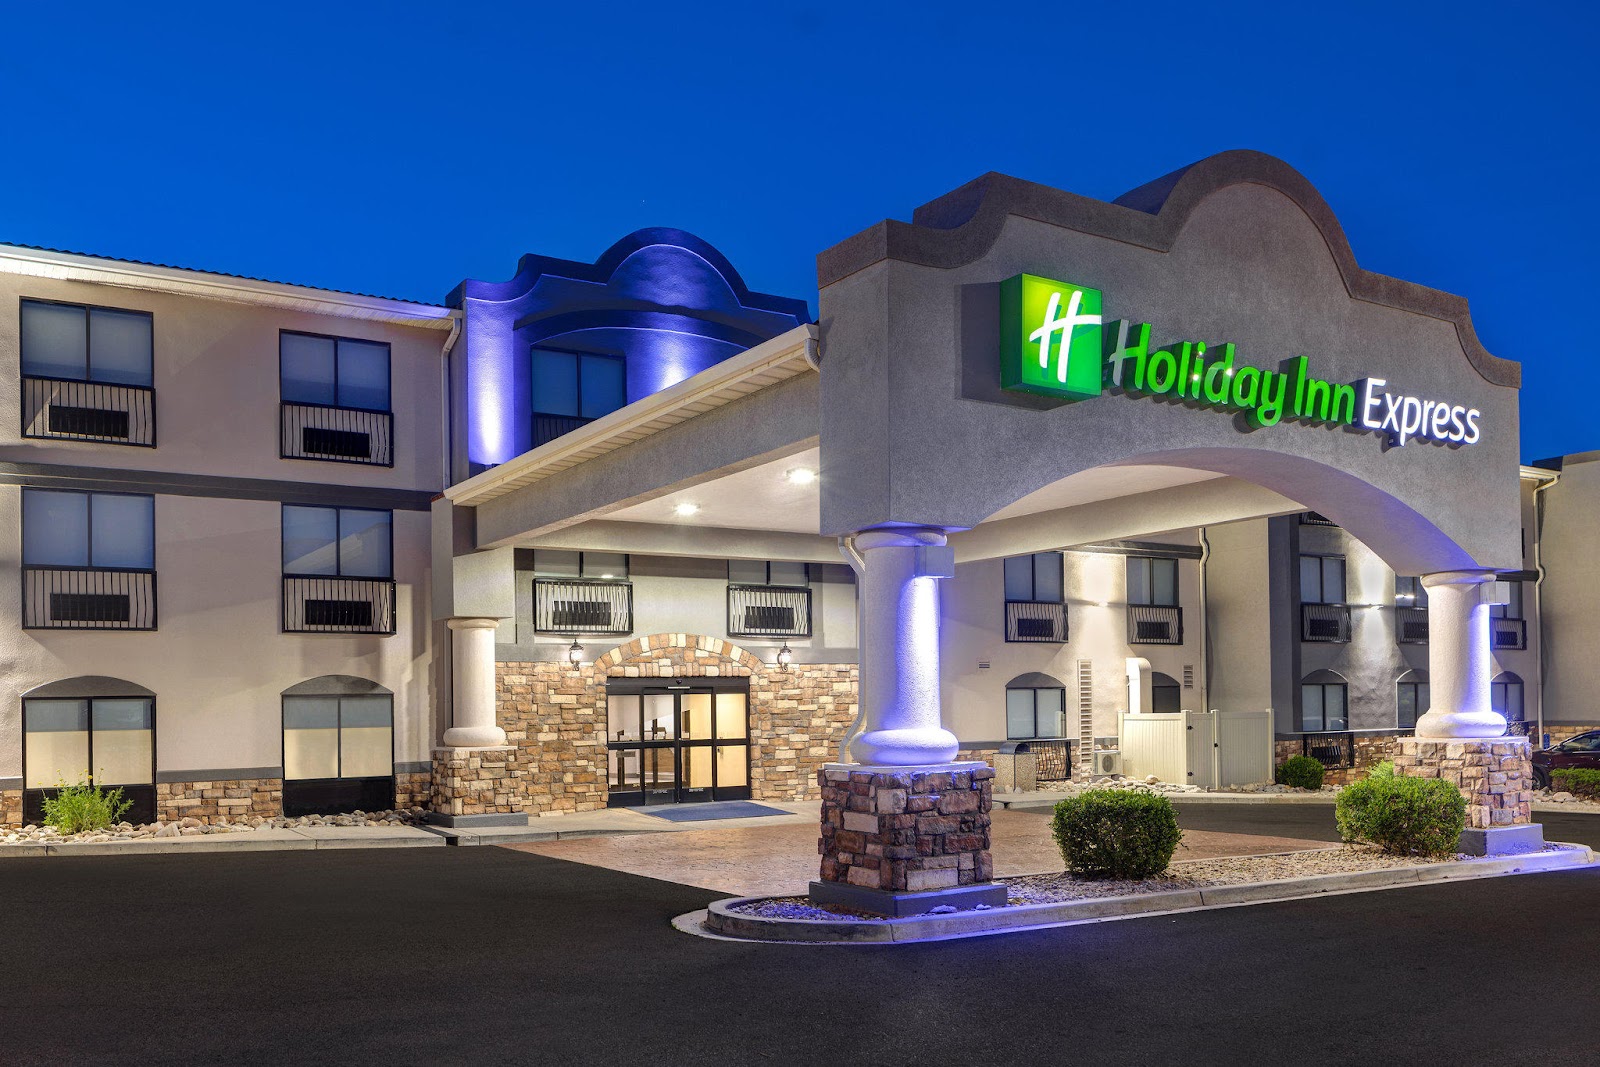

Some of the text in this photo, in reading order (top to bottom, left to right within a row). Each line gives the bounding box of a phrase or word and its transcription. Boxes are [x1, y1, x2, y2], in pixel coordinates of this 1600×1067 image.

[1108, 318, 1480, 447] Holiday Inn Express
